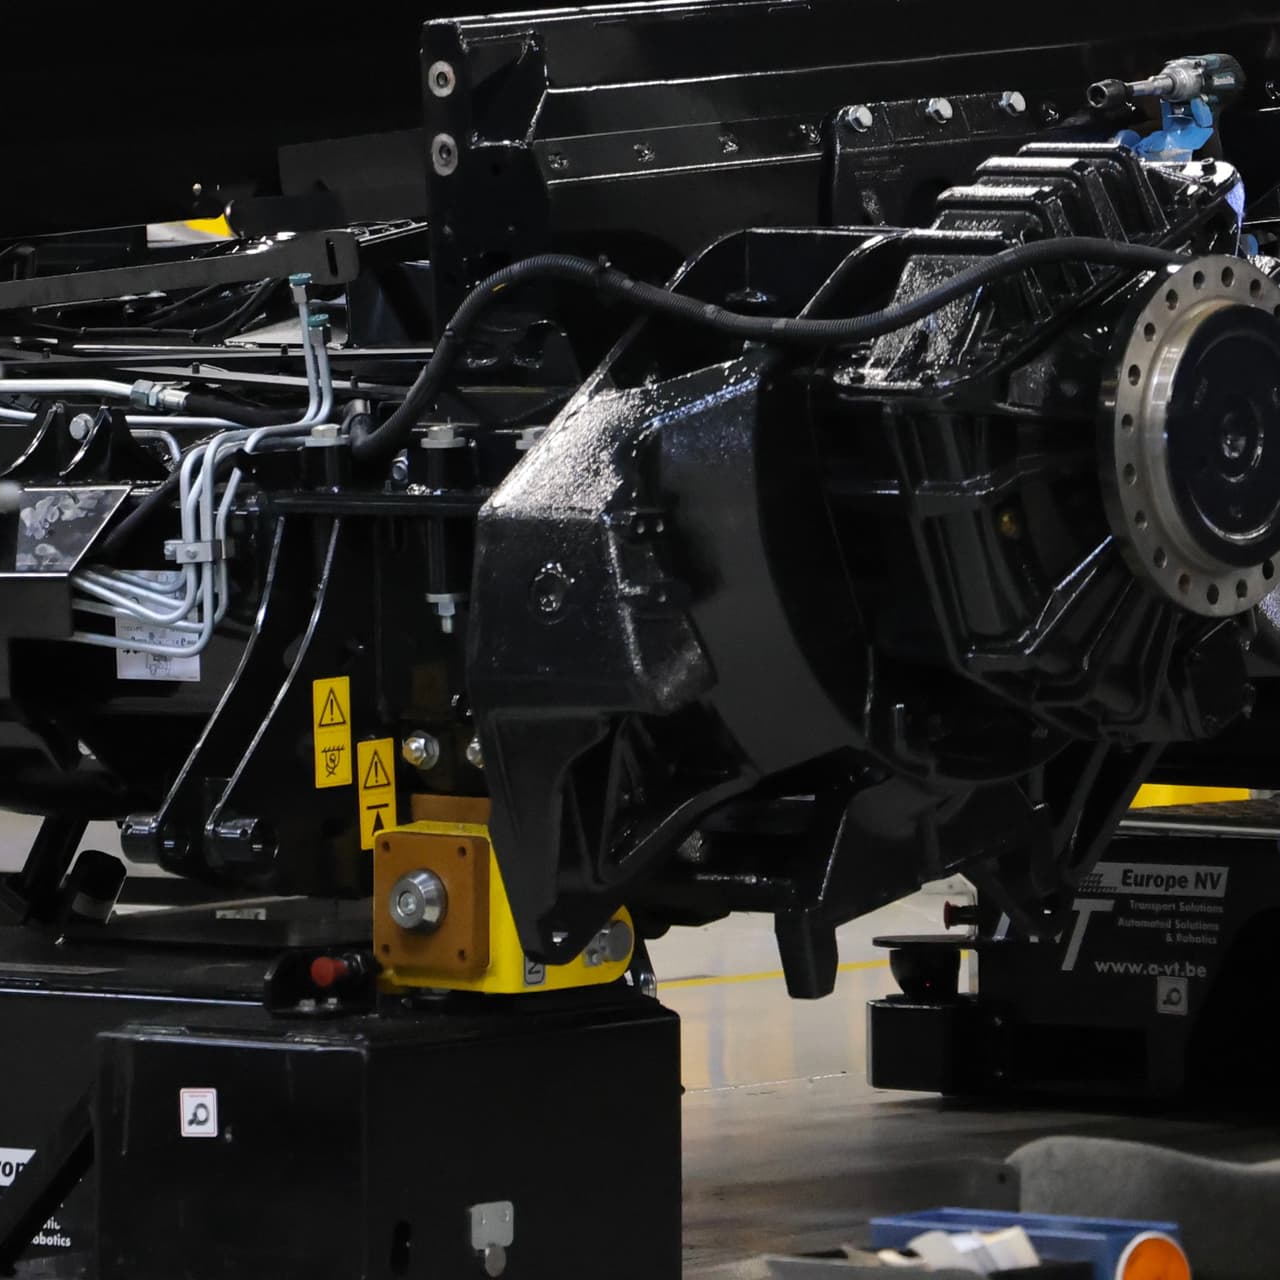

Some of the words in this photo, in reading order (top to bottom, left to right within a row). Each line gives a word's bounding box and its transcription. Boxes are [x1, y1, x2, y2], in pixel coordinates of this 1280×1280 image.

[1121, 869, 1189, 892] Europe
[1194, 872, 1222, 890] NV
[1129, 899, 1176, 914] Transport
[1179, 901, 1224, 914] Solutions
[1175, 919, 1220, 931] Solutions
[1094, 960, 1208, 978] www.a-vt.be
[31, 1232, 71, 1247] obotics
